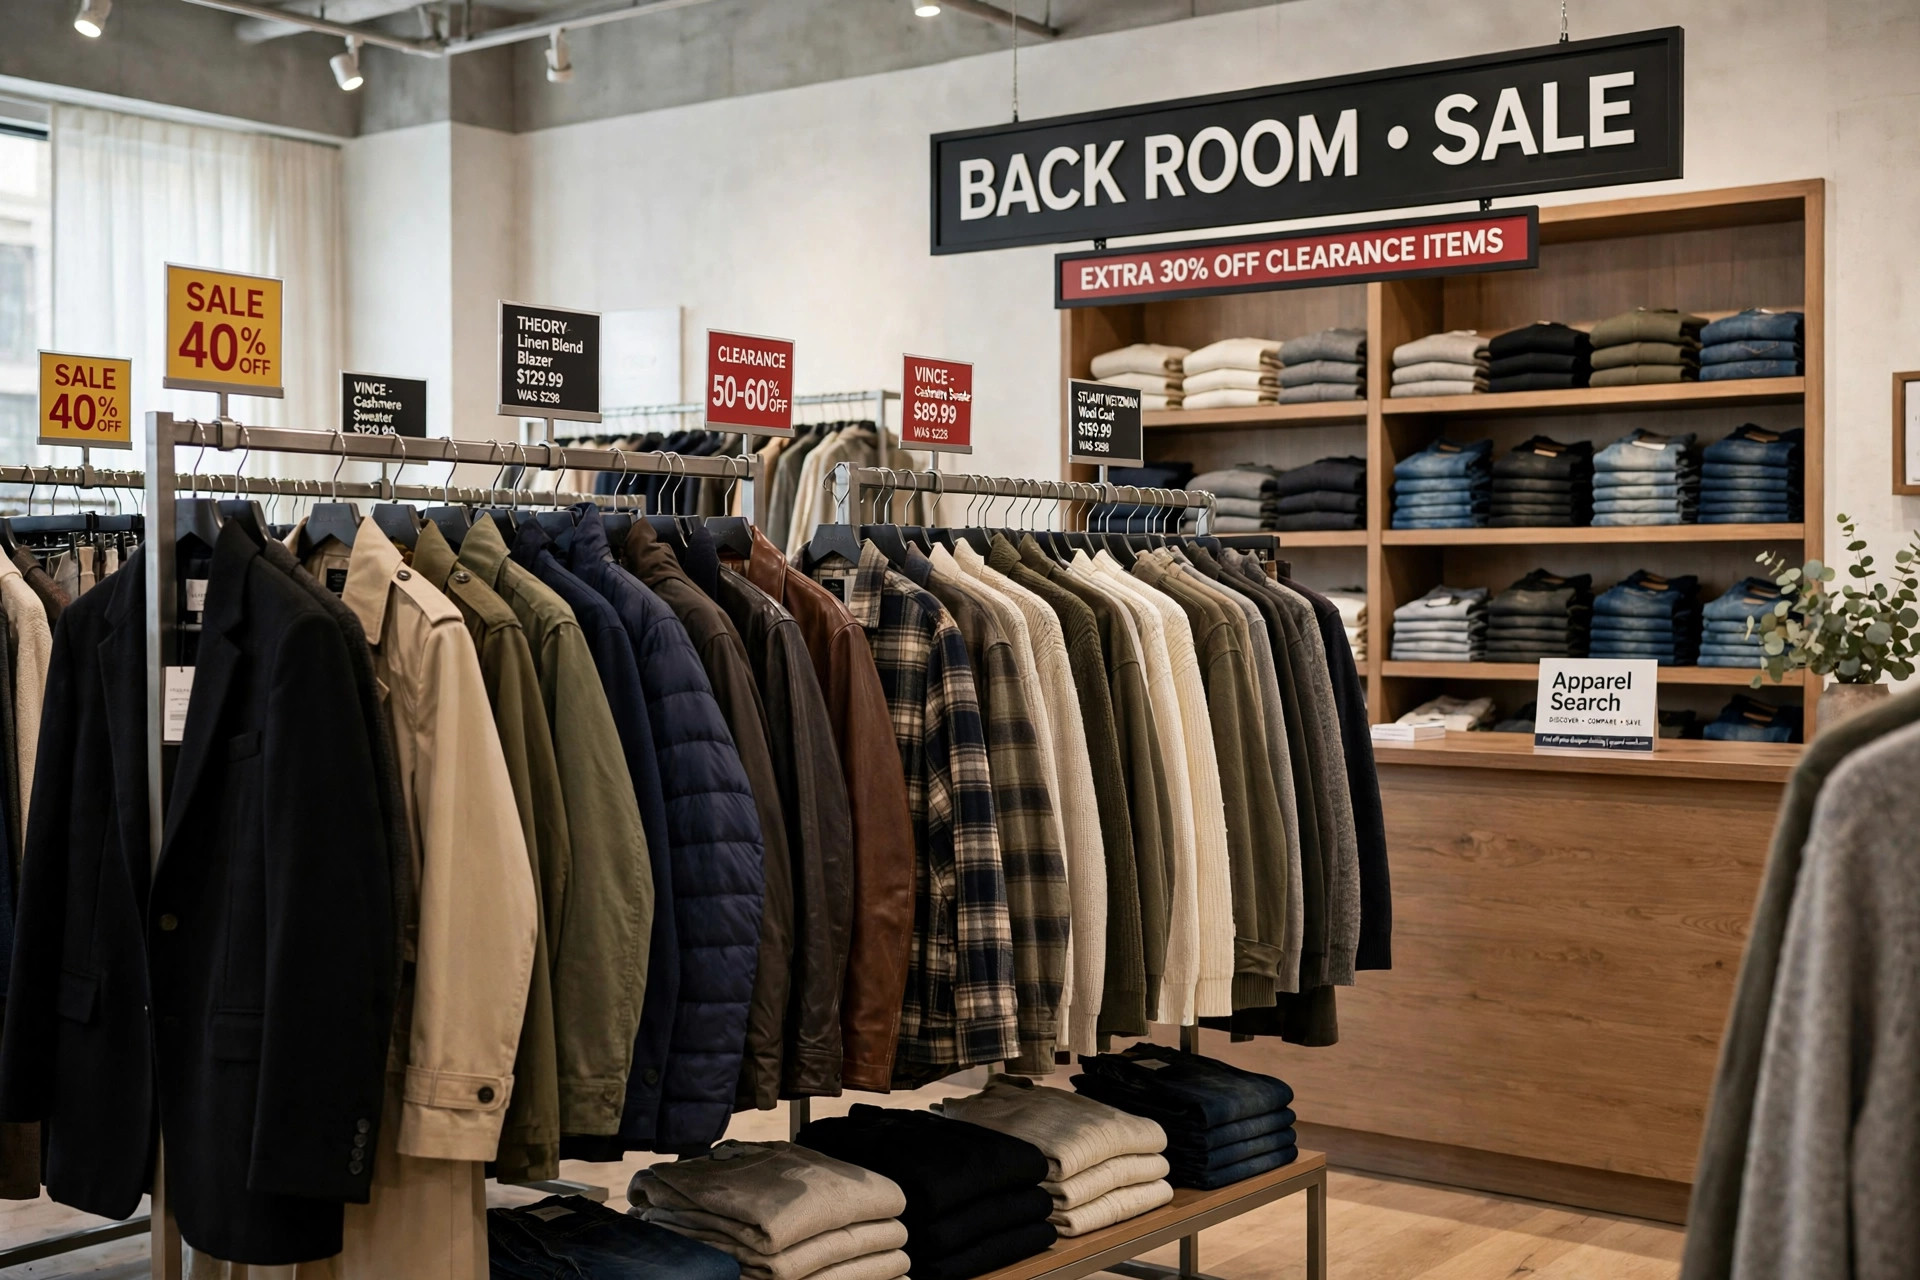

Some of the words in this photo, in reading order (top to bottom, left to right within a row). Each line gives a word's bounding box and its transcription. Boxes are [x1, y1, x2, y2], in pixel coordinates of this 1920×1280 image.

[958, 139, 1127, 221] BACK
[1144, 108, 1359, 201] ROOM
[1431, 70, 1636, 166] SALE
[1080, 256, 1155, 291] EXTRA
[1159, 254, 1210, 284] 30%
[1213, 248, 1261, 279] OFF
[1265, 234, 1417, 275] CLEARANCE
[1421, 227, 1505, 260] ITEMS
[186, 281, 264, 319] SALE
[178, 321, 266, 371] 40%
[239, 358, 271, 376] OFF
[517, 333, 549, 351] Linen
[552, 337, 583, 354] Blend
[517, 350, 553, 367] Blazer
[718, 345, 786, 369] CLEARANCE
[55, 363, 116, 390] SALE
[516, 367, 564, 388] $129.99
[914, 366, 948, 385] VINCE
[354, 381, 386, 396] VINCE
[517, 389, 538, 402] WAS
[540, 391, 560, 404] $298
[712, 374, 780, 412] 50-60%
[769, 397, 788, 413] OFF
[49, 393, 118, 431] 40%
[97, 419, 122, 433] OFF
[353, 395, 402, 411] Cashmere
[913, 400, 957, 424] $89.99
[1078, 405, 1097, 419] Wool
[353, 408, 394, 424] Sweater
[353, 422, 396, 436] $12999
[913, 426, 930, 439] WAS
[1078, 422, 1112, 437] $159.99
[1552, 671, 1632, 694] Apparel
[1551, 692, 1621, 711] Search
[1549, 716, 1579, 724] DISCOVER
[1587, 717, 1617, 725] COMPARE
